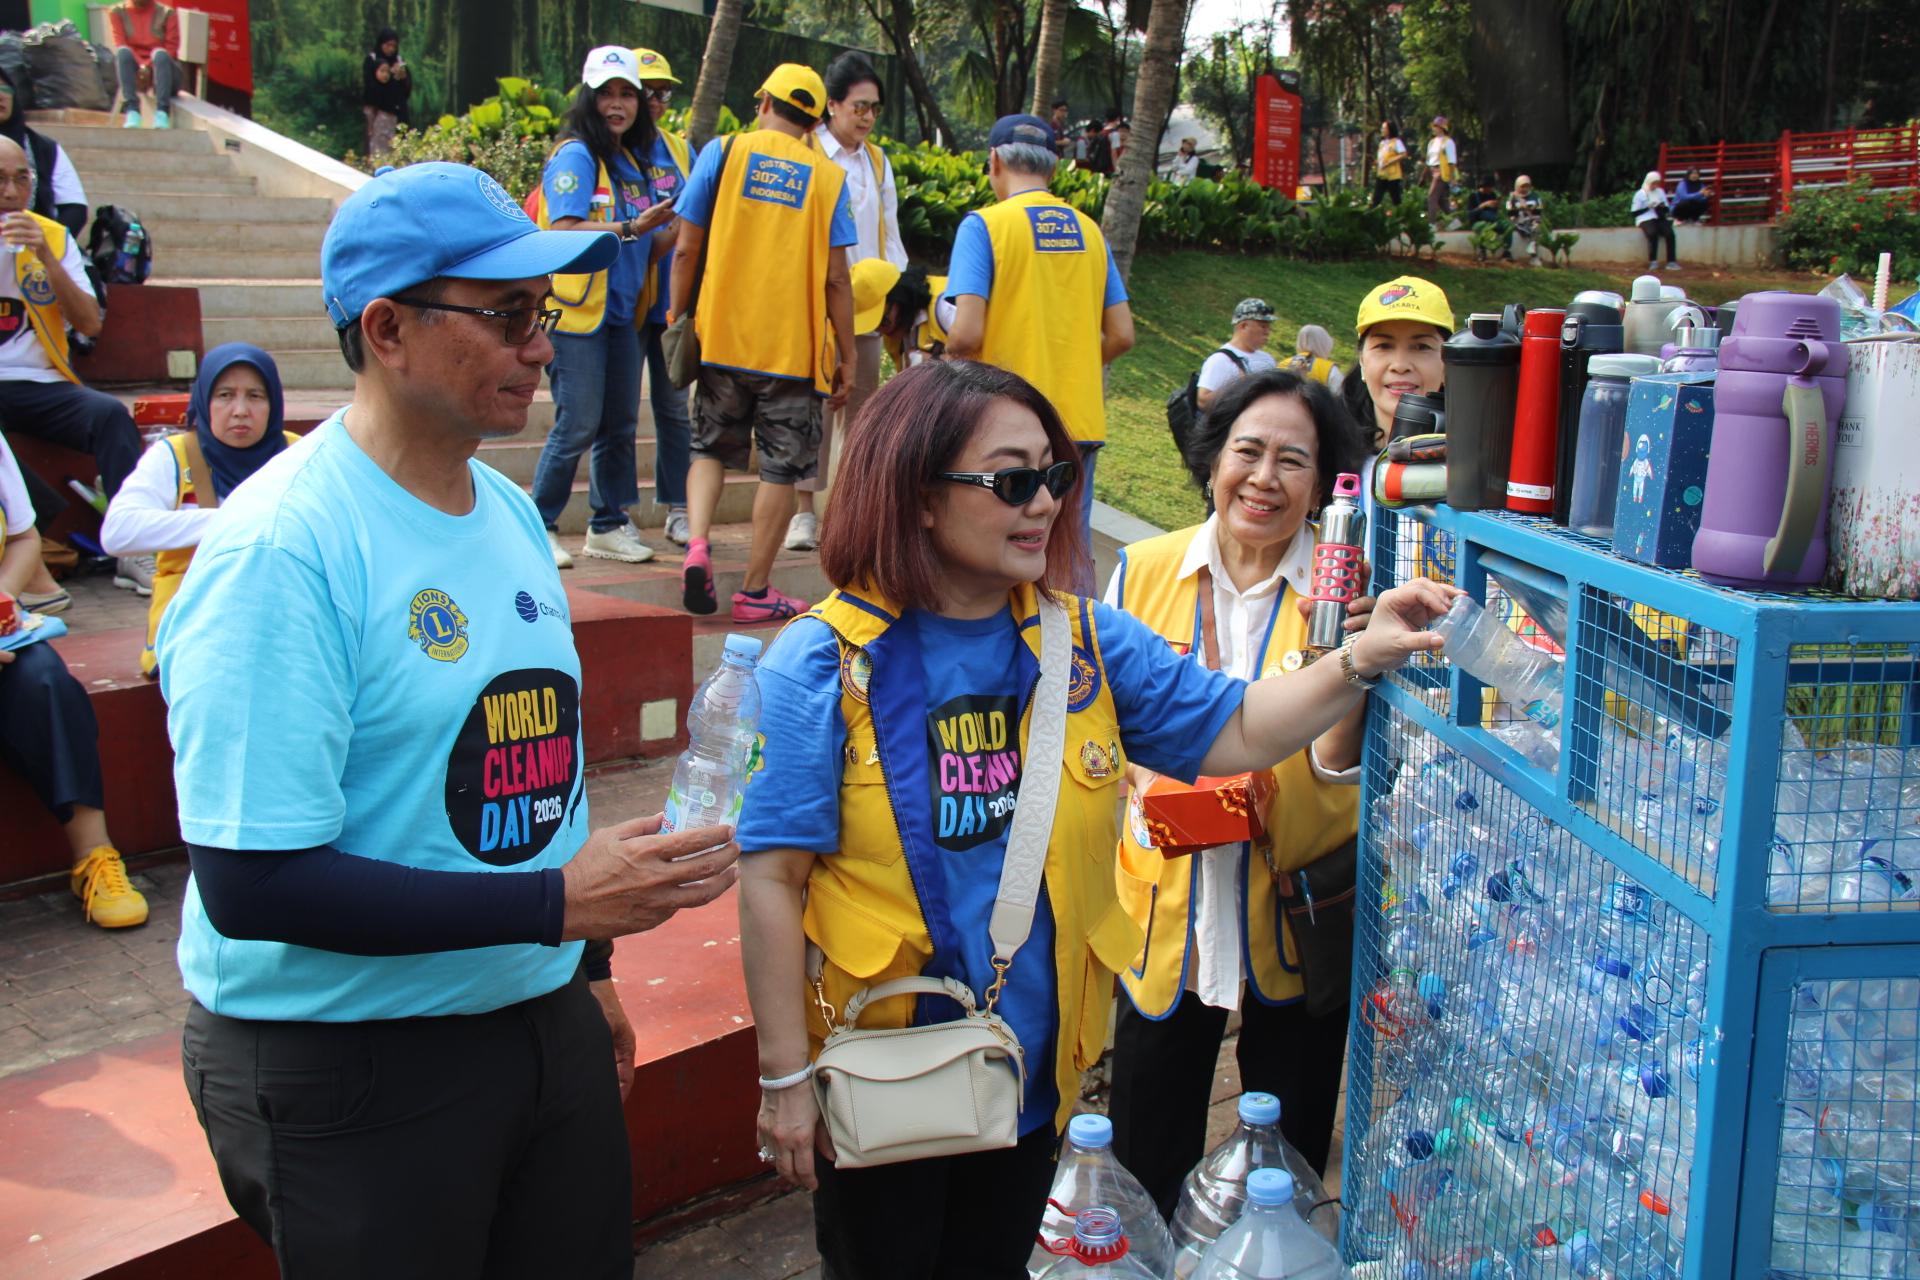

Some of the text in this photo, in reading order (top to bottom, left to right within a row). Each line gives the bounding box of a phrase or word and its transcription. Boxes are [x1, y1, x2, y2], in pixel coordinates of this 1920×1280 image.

[760, 160, 799, 176] DISTRICT
[750, 186, 796, 203] INDONESIA
[1836, 432, 1854, 443] YOU
[1838, 421, 1861, 431] HANK
[1805, 422, 1819, 466] THERMOS
[412, 591, 447, 611] LIONS
[429, 611, 452, 638] L
[483, 687, 558, 744] WORLD
[483, 736, 572, 798] CLEANUP
[940, 751, 1018, 793] CLENU
[479, 795, 562, 852] DAY 2026
[938, 796, 987, 838] DAY
